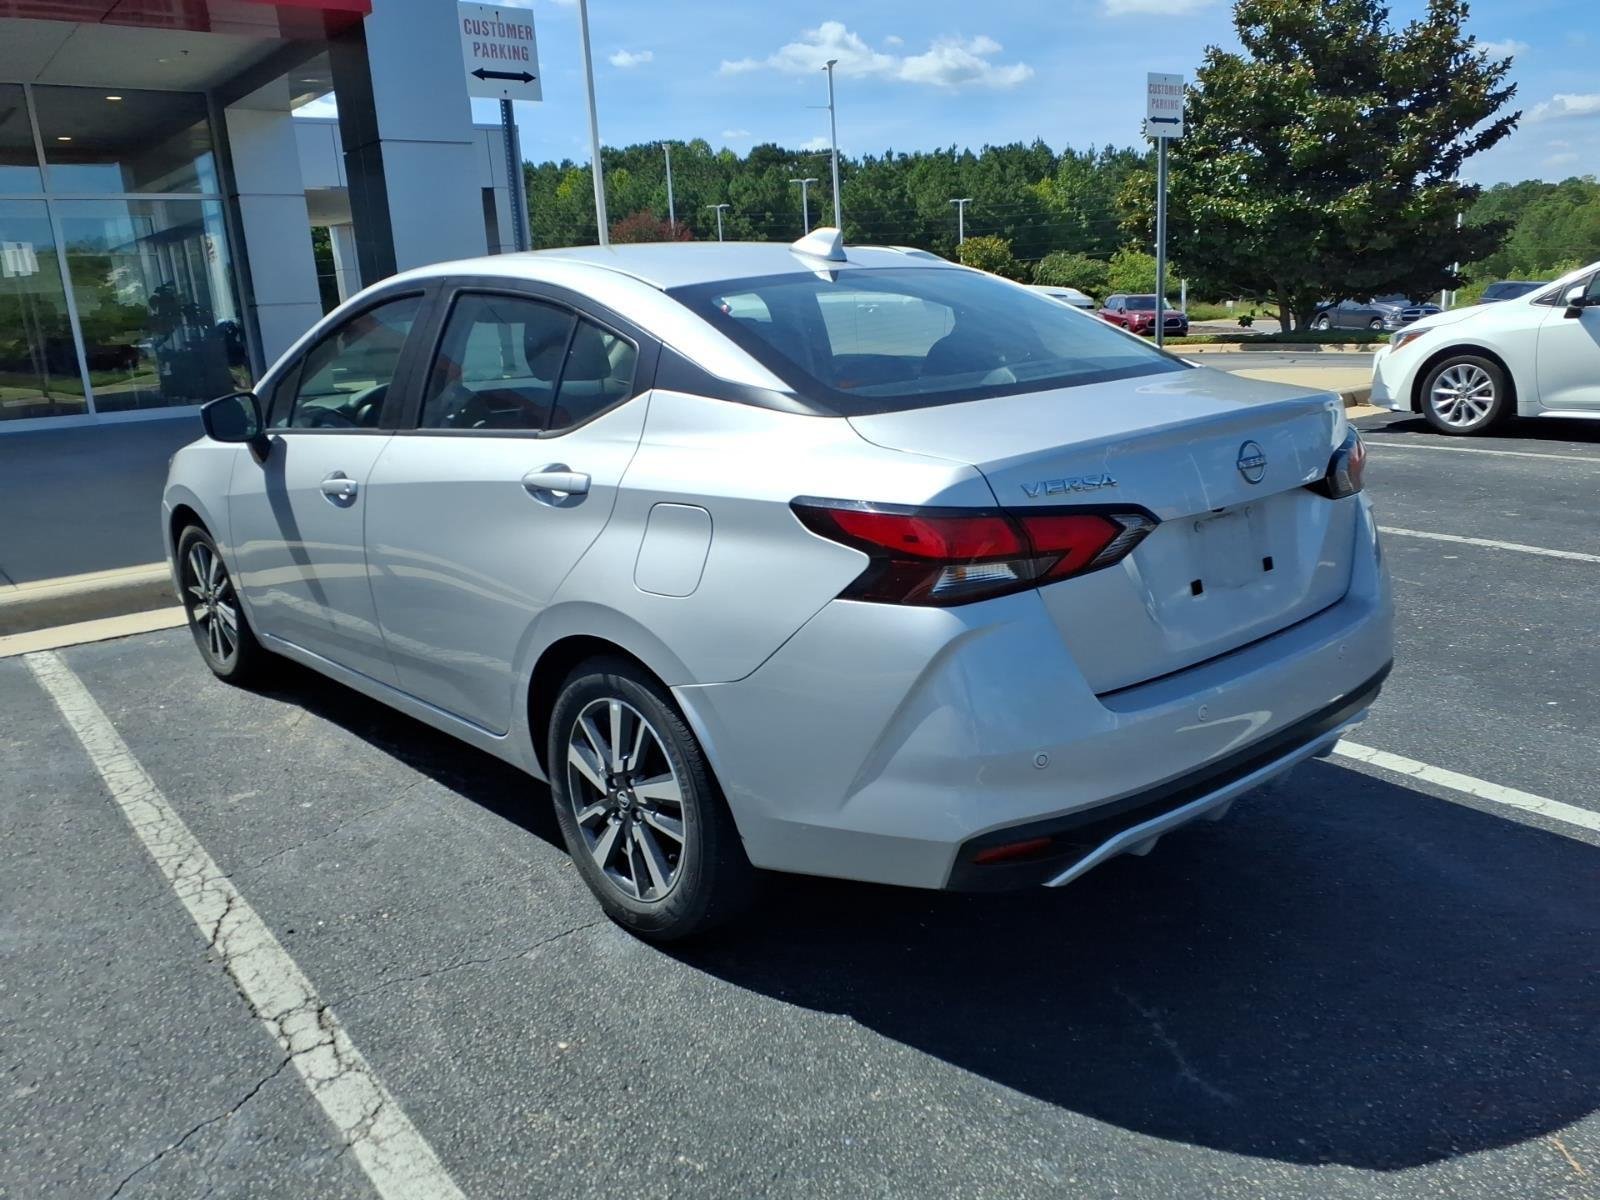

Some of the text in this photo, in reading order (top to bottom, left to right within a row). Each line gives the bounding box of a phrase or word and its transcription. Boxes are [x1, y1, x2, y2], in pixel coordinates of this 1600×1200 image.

[463, 18, 533, 41] CUSTOMER
[473, 41, 529, 61] PARKING
[1148, 83, 1183, 96] CUSTOMER
[1151, 98, 1179, 110] PARKING
[1020, 473, 1118, 498] VERSA
